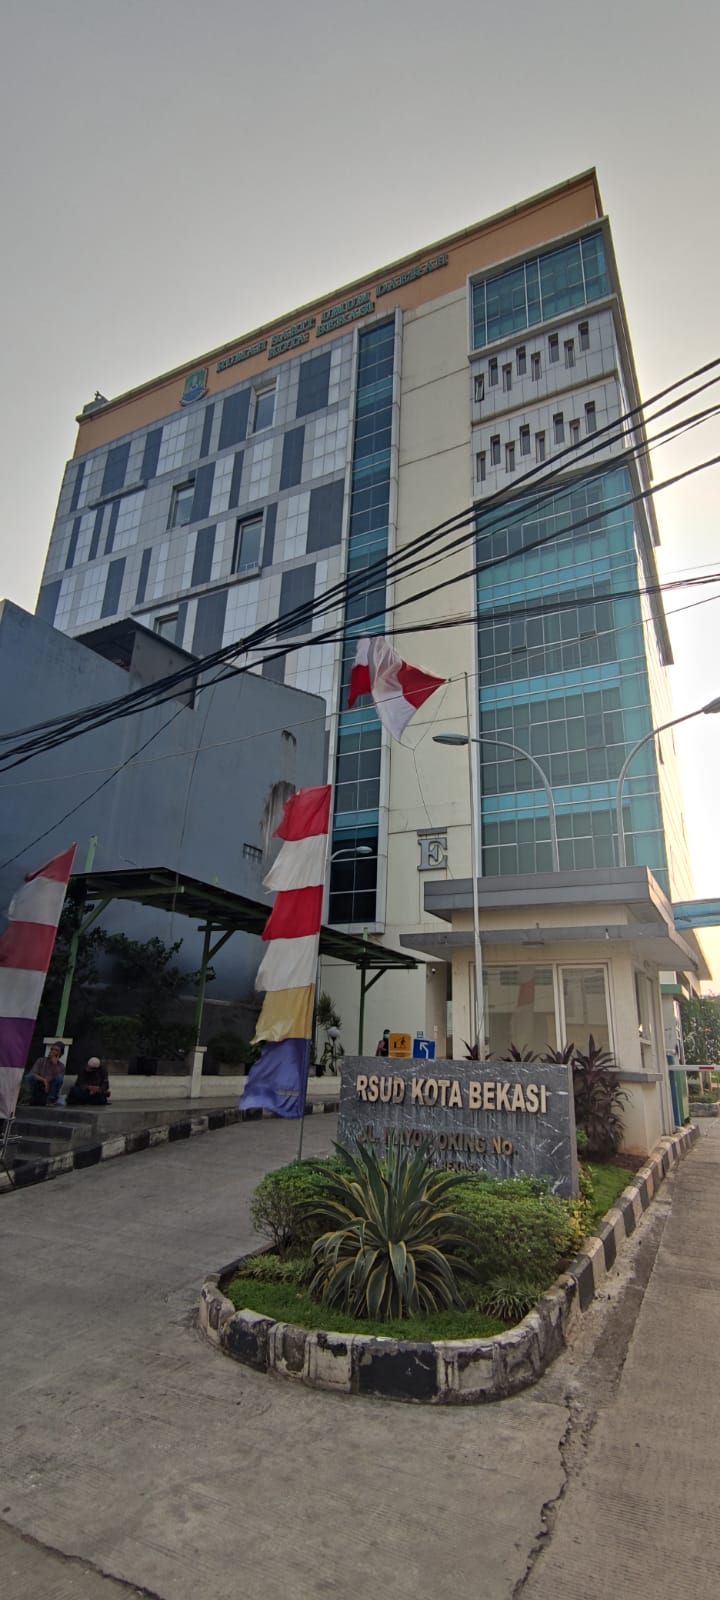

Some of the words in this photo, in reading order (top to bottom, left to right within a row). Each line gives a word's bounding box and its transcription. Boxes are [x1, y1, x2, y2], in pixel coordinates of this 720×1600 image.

[417, 837, 448, 871] E
[357, 1075, 404, 1104] RSUD
[411, 1078, 463, 1108] KOTA
[469, 1081, 547, 1113] BEKASI
